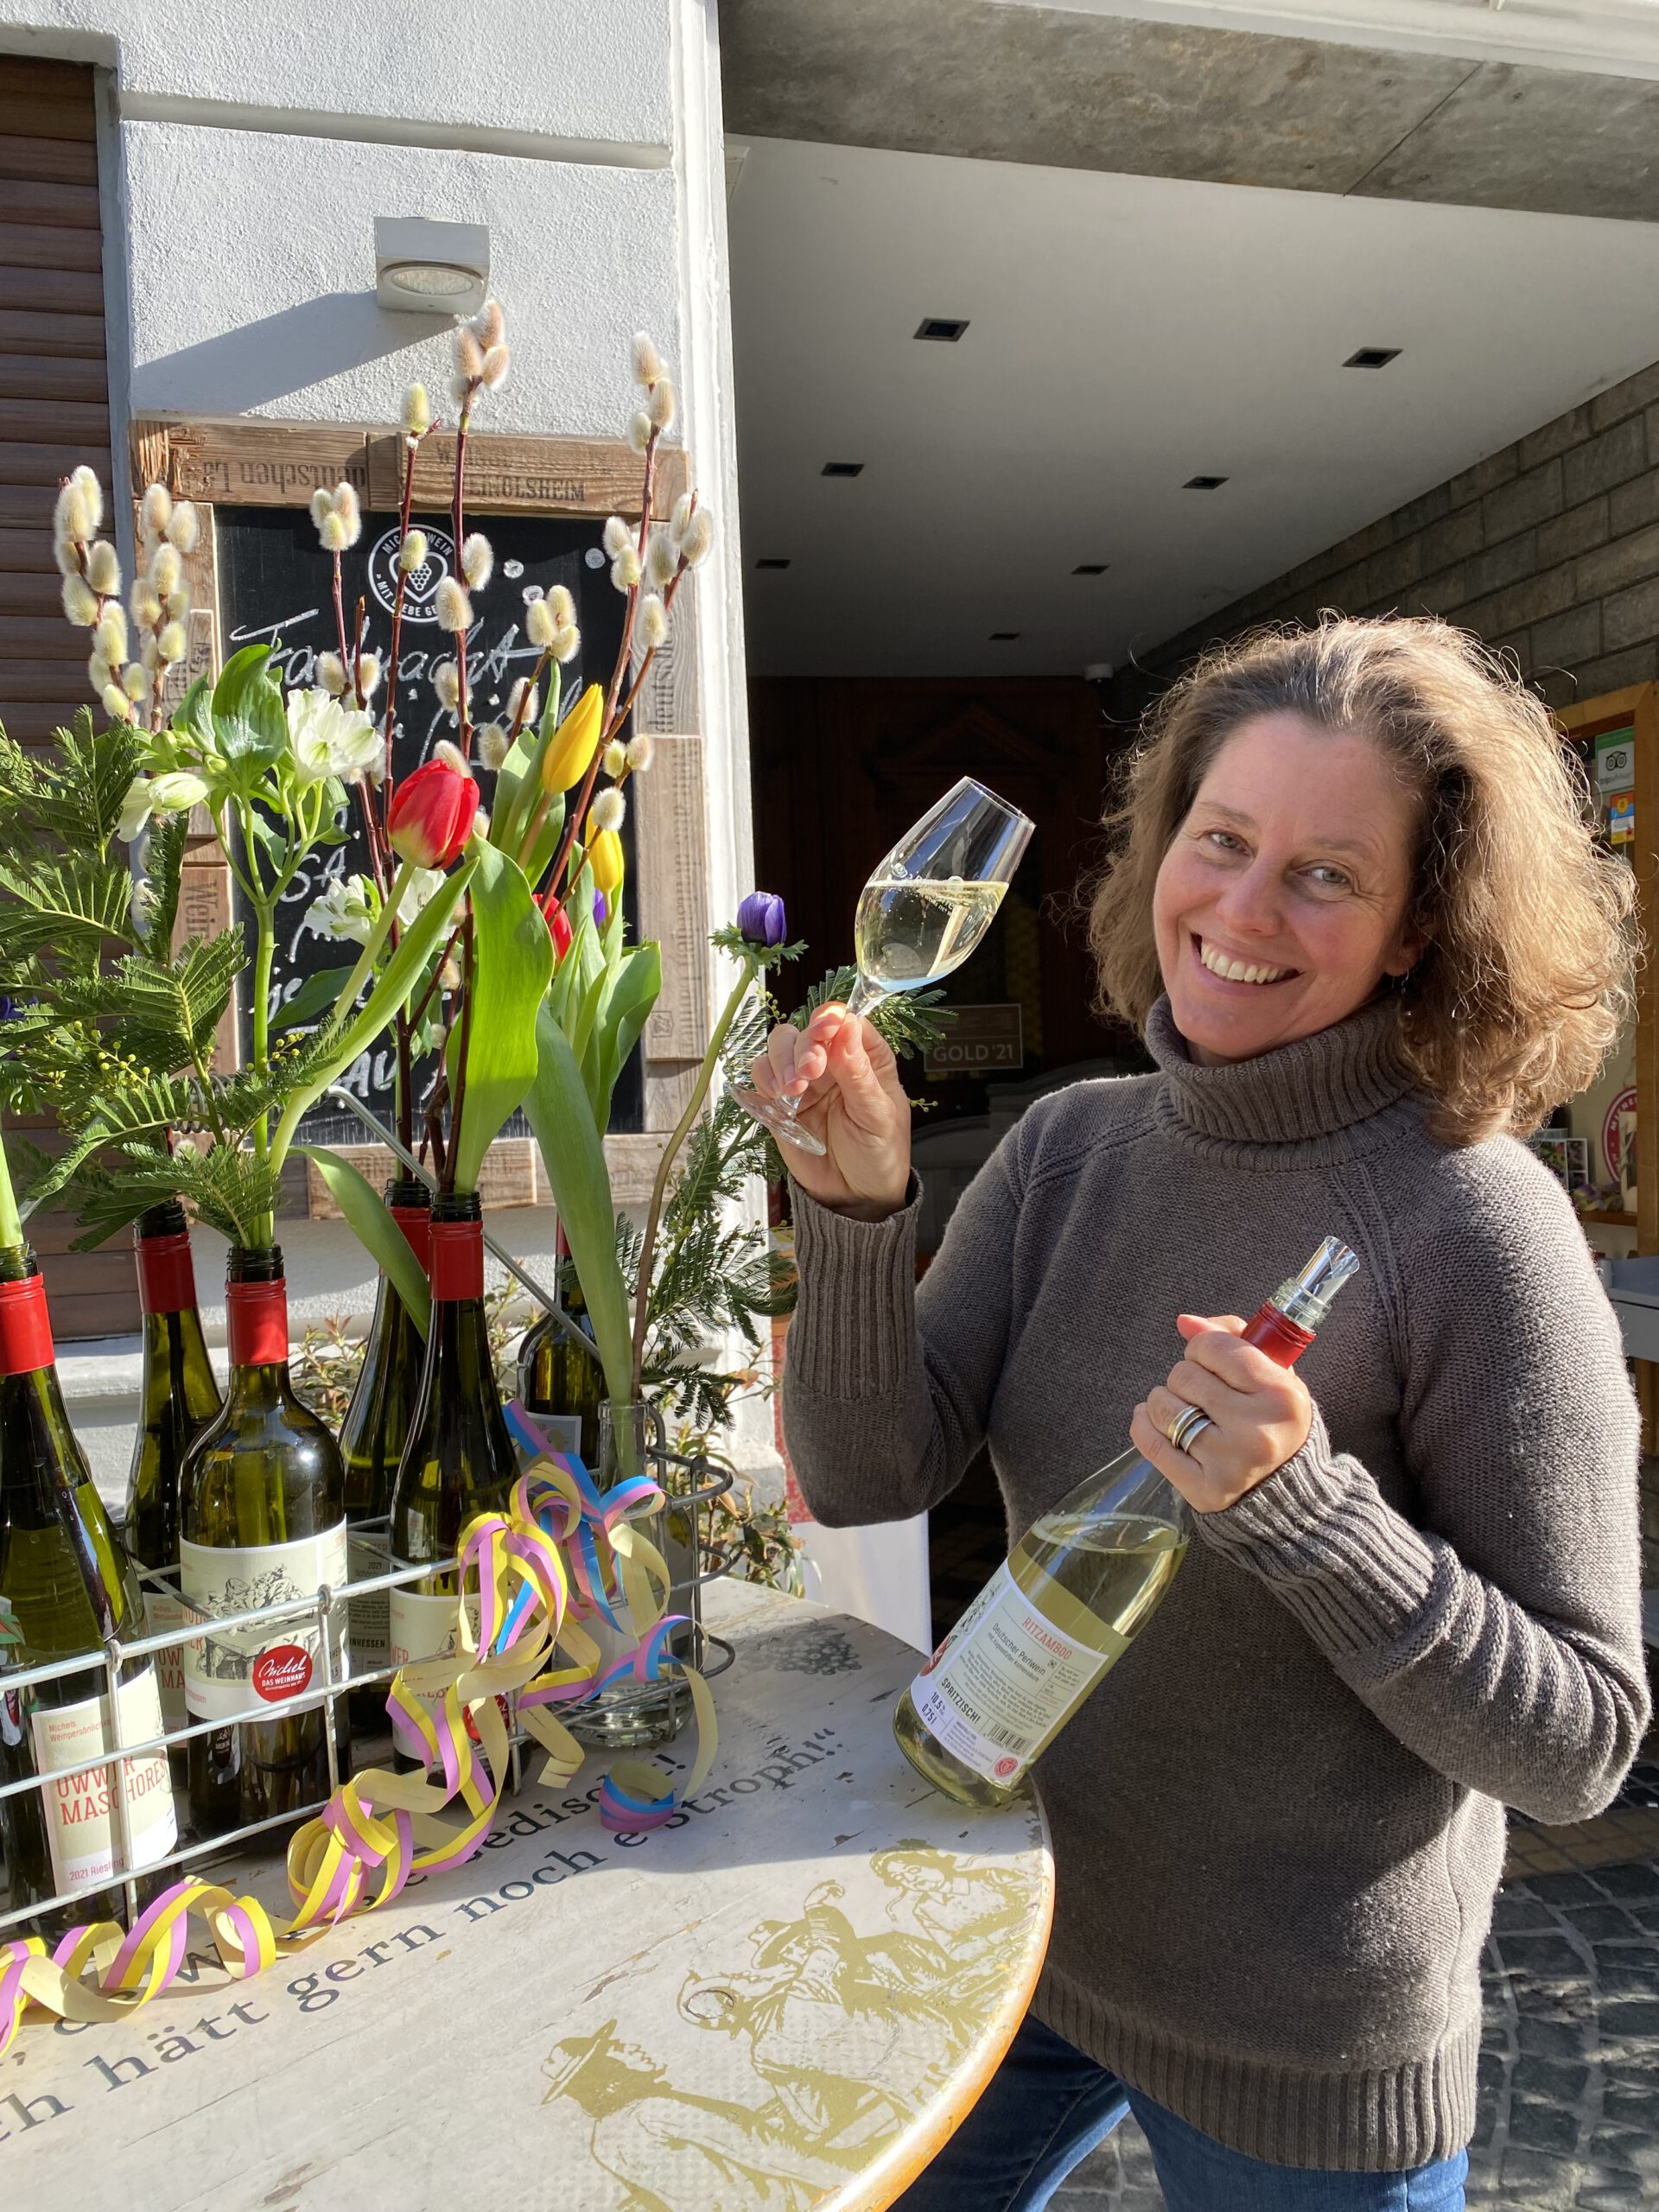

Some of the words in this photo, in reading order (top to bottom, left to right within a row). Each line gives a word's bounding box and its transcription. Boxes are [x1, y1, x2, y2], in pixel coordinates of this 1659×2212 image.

[427, 532, 454, 556] WEIN
[377, 580, 394, 600] MIT
[391, 598, 422, 617] LEBE
[230, 608, 545, 687] Fanacht
[648, 617, 675, 733] deutsch
[933, 1045, 989, 1063] GOLD
[349, 1637, 385, 1649] INHESSEN
[992, 1622, 1020, 1655] Deutscher
[1021, 1617, 1073, 1660] RITZAMBOO
[262, 1679, 274, 1688] DAS
[275, 1672, 306, 1685] WEINHAUS
[941, 1677, 982, 1725] SPRITZISCH!
[48, 1719, 77, 1732] Michels
[56, 1756, 136, 1798] UWWR
[70, 1866, 89, 1881] 2021
[91, 1857, 125, 1876] Riesling
[0, 2093, 75, 2142] h
[82, 2000, 270, 2093] hätt
[286, 1923, 446, 2013] gern
[453, 1849, 608, 1923] noch
[613, 1830, 650, 1848] e
